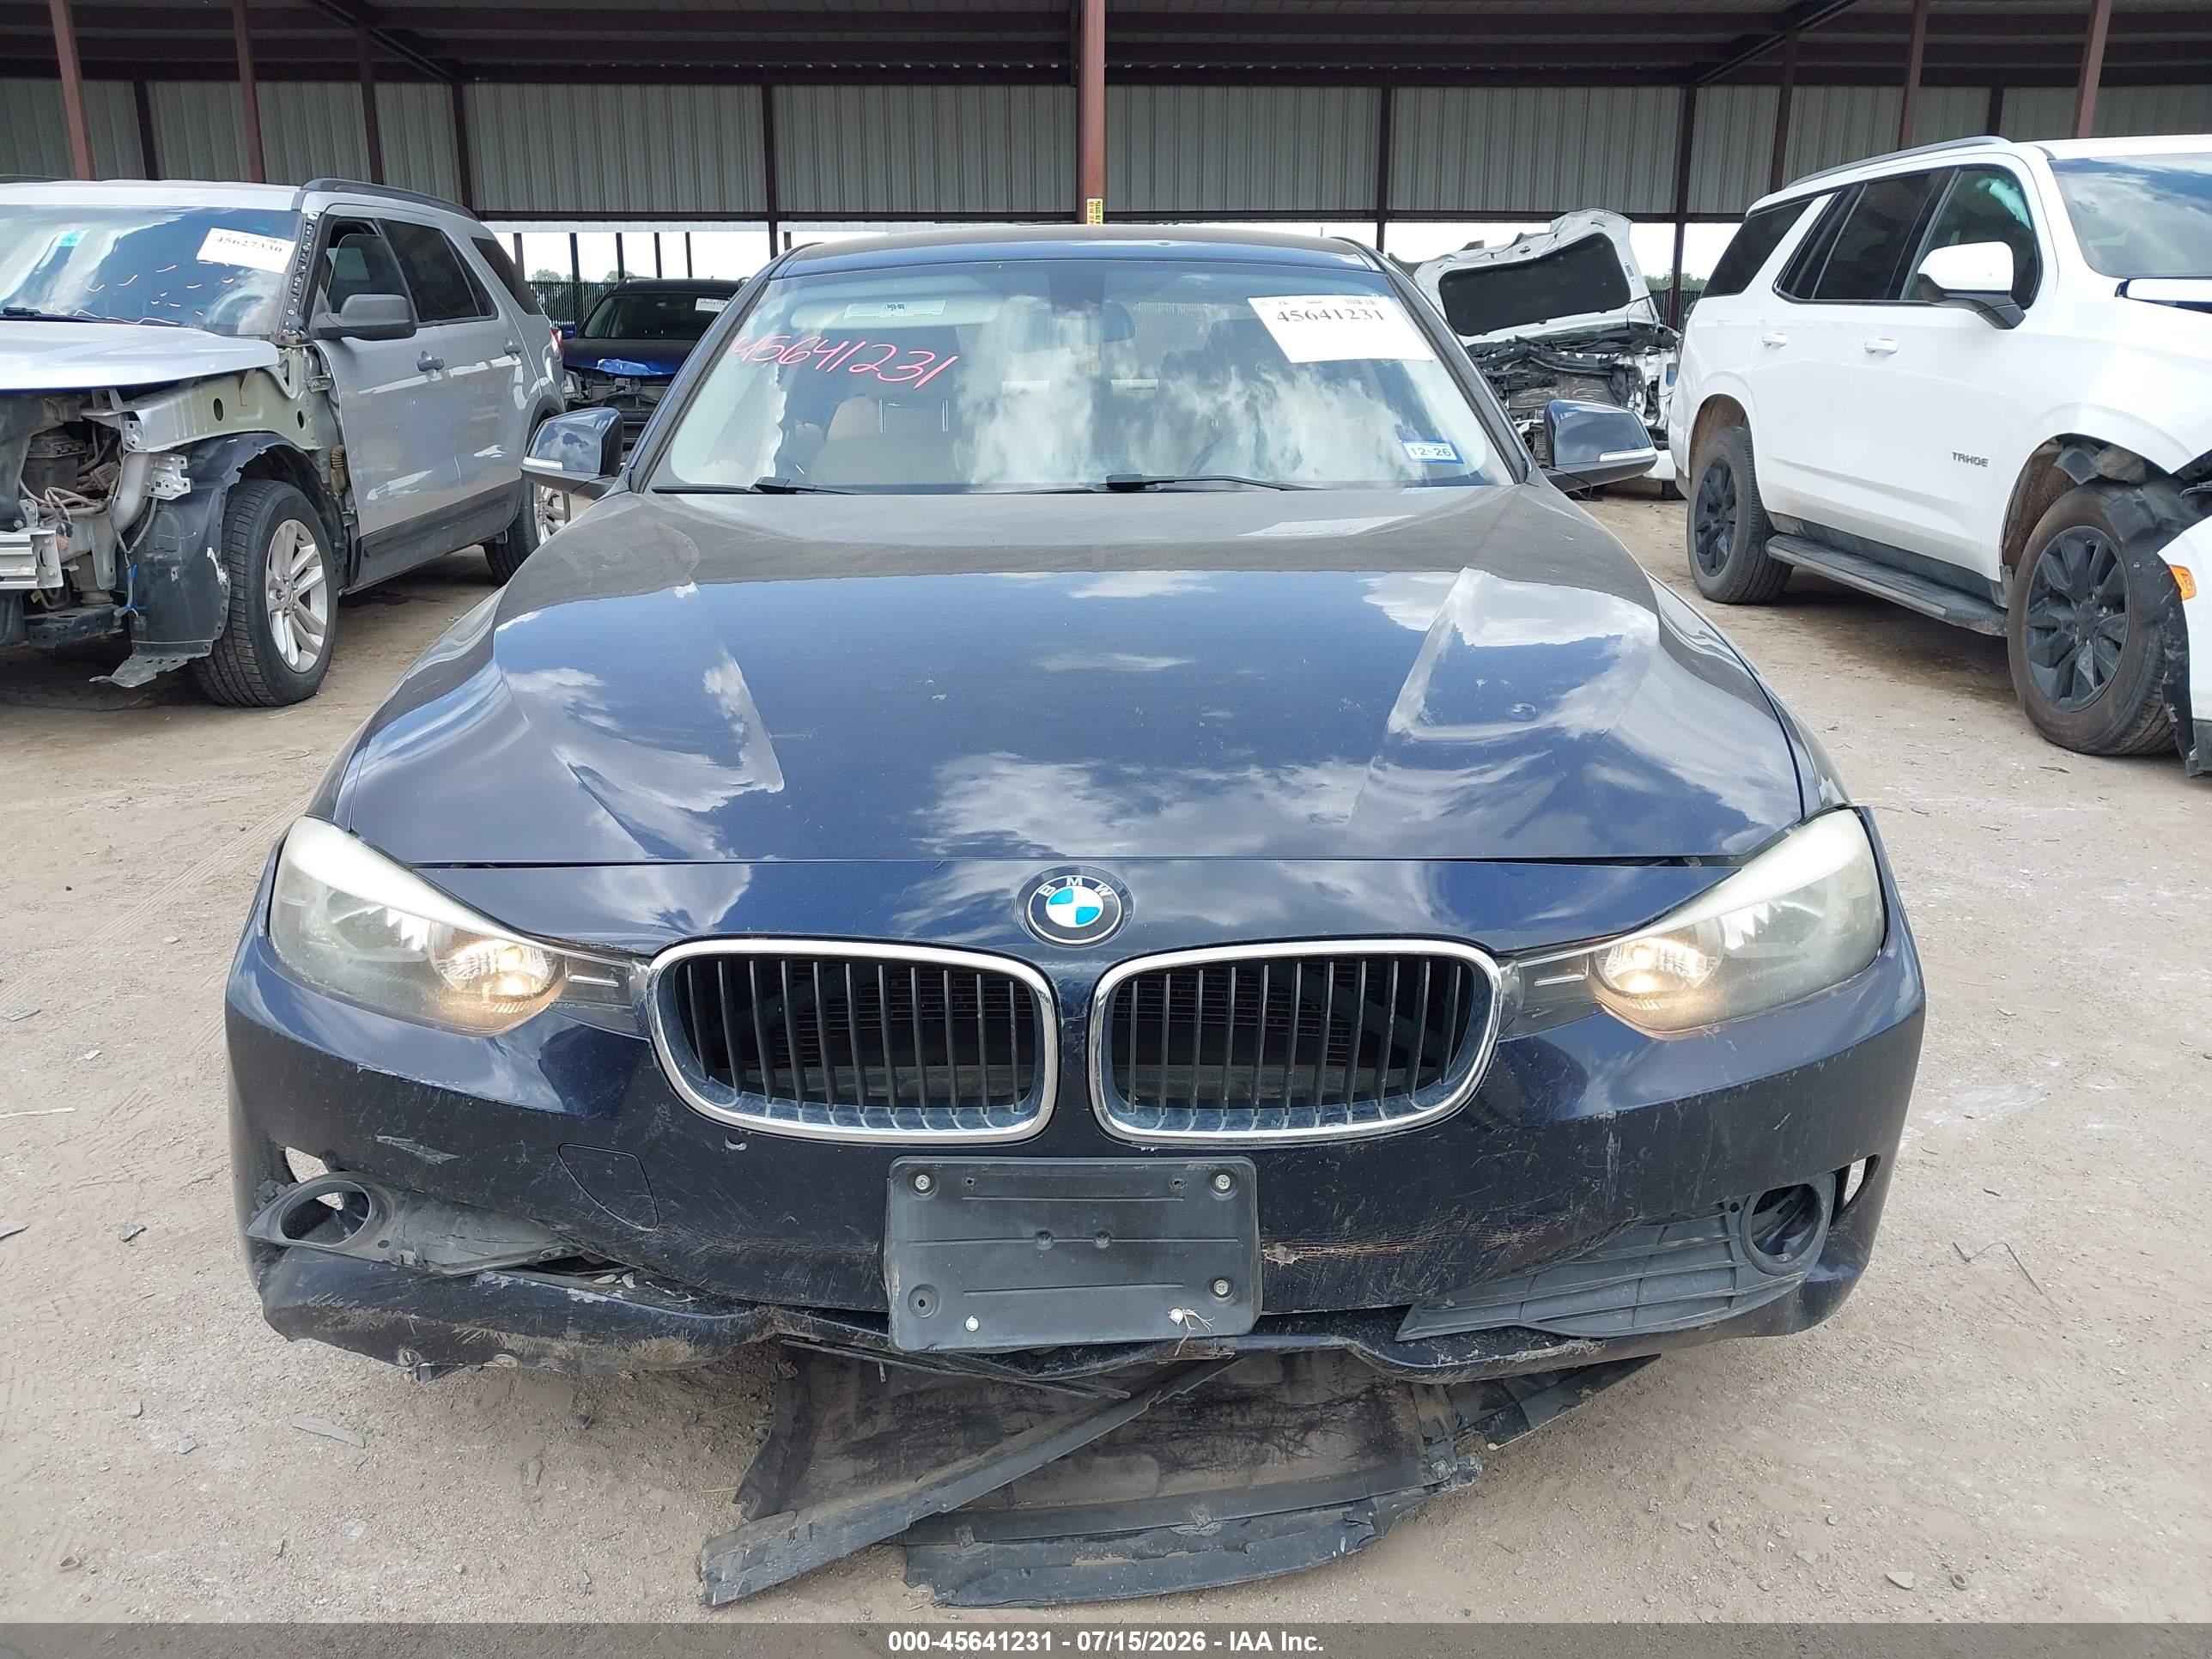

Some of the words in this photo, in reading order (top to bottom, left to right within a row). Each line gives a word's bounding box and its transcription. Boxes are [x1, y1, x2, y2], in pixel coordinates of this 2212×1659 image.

[1277, 308, 1385, 322] 45641231
[732, 335, 959, 390] 45641231
[1952, 452, 1990, 468] TAHOE
[1037, 876, 1114, 898] BMW
